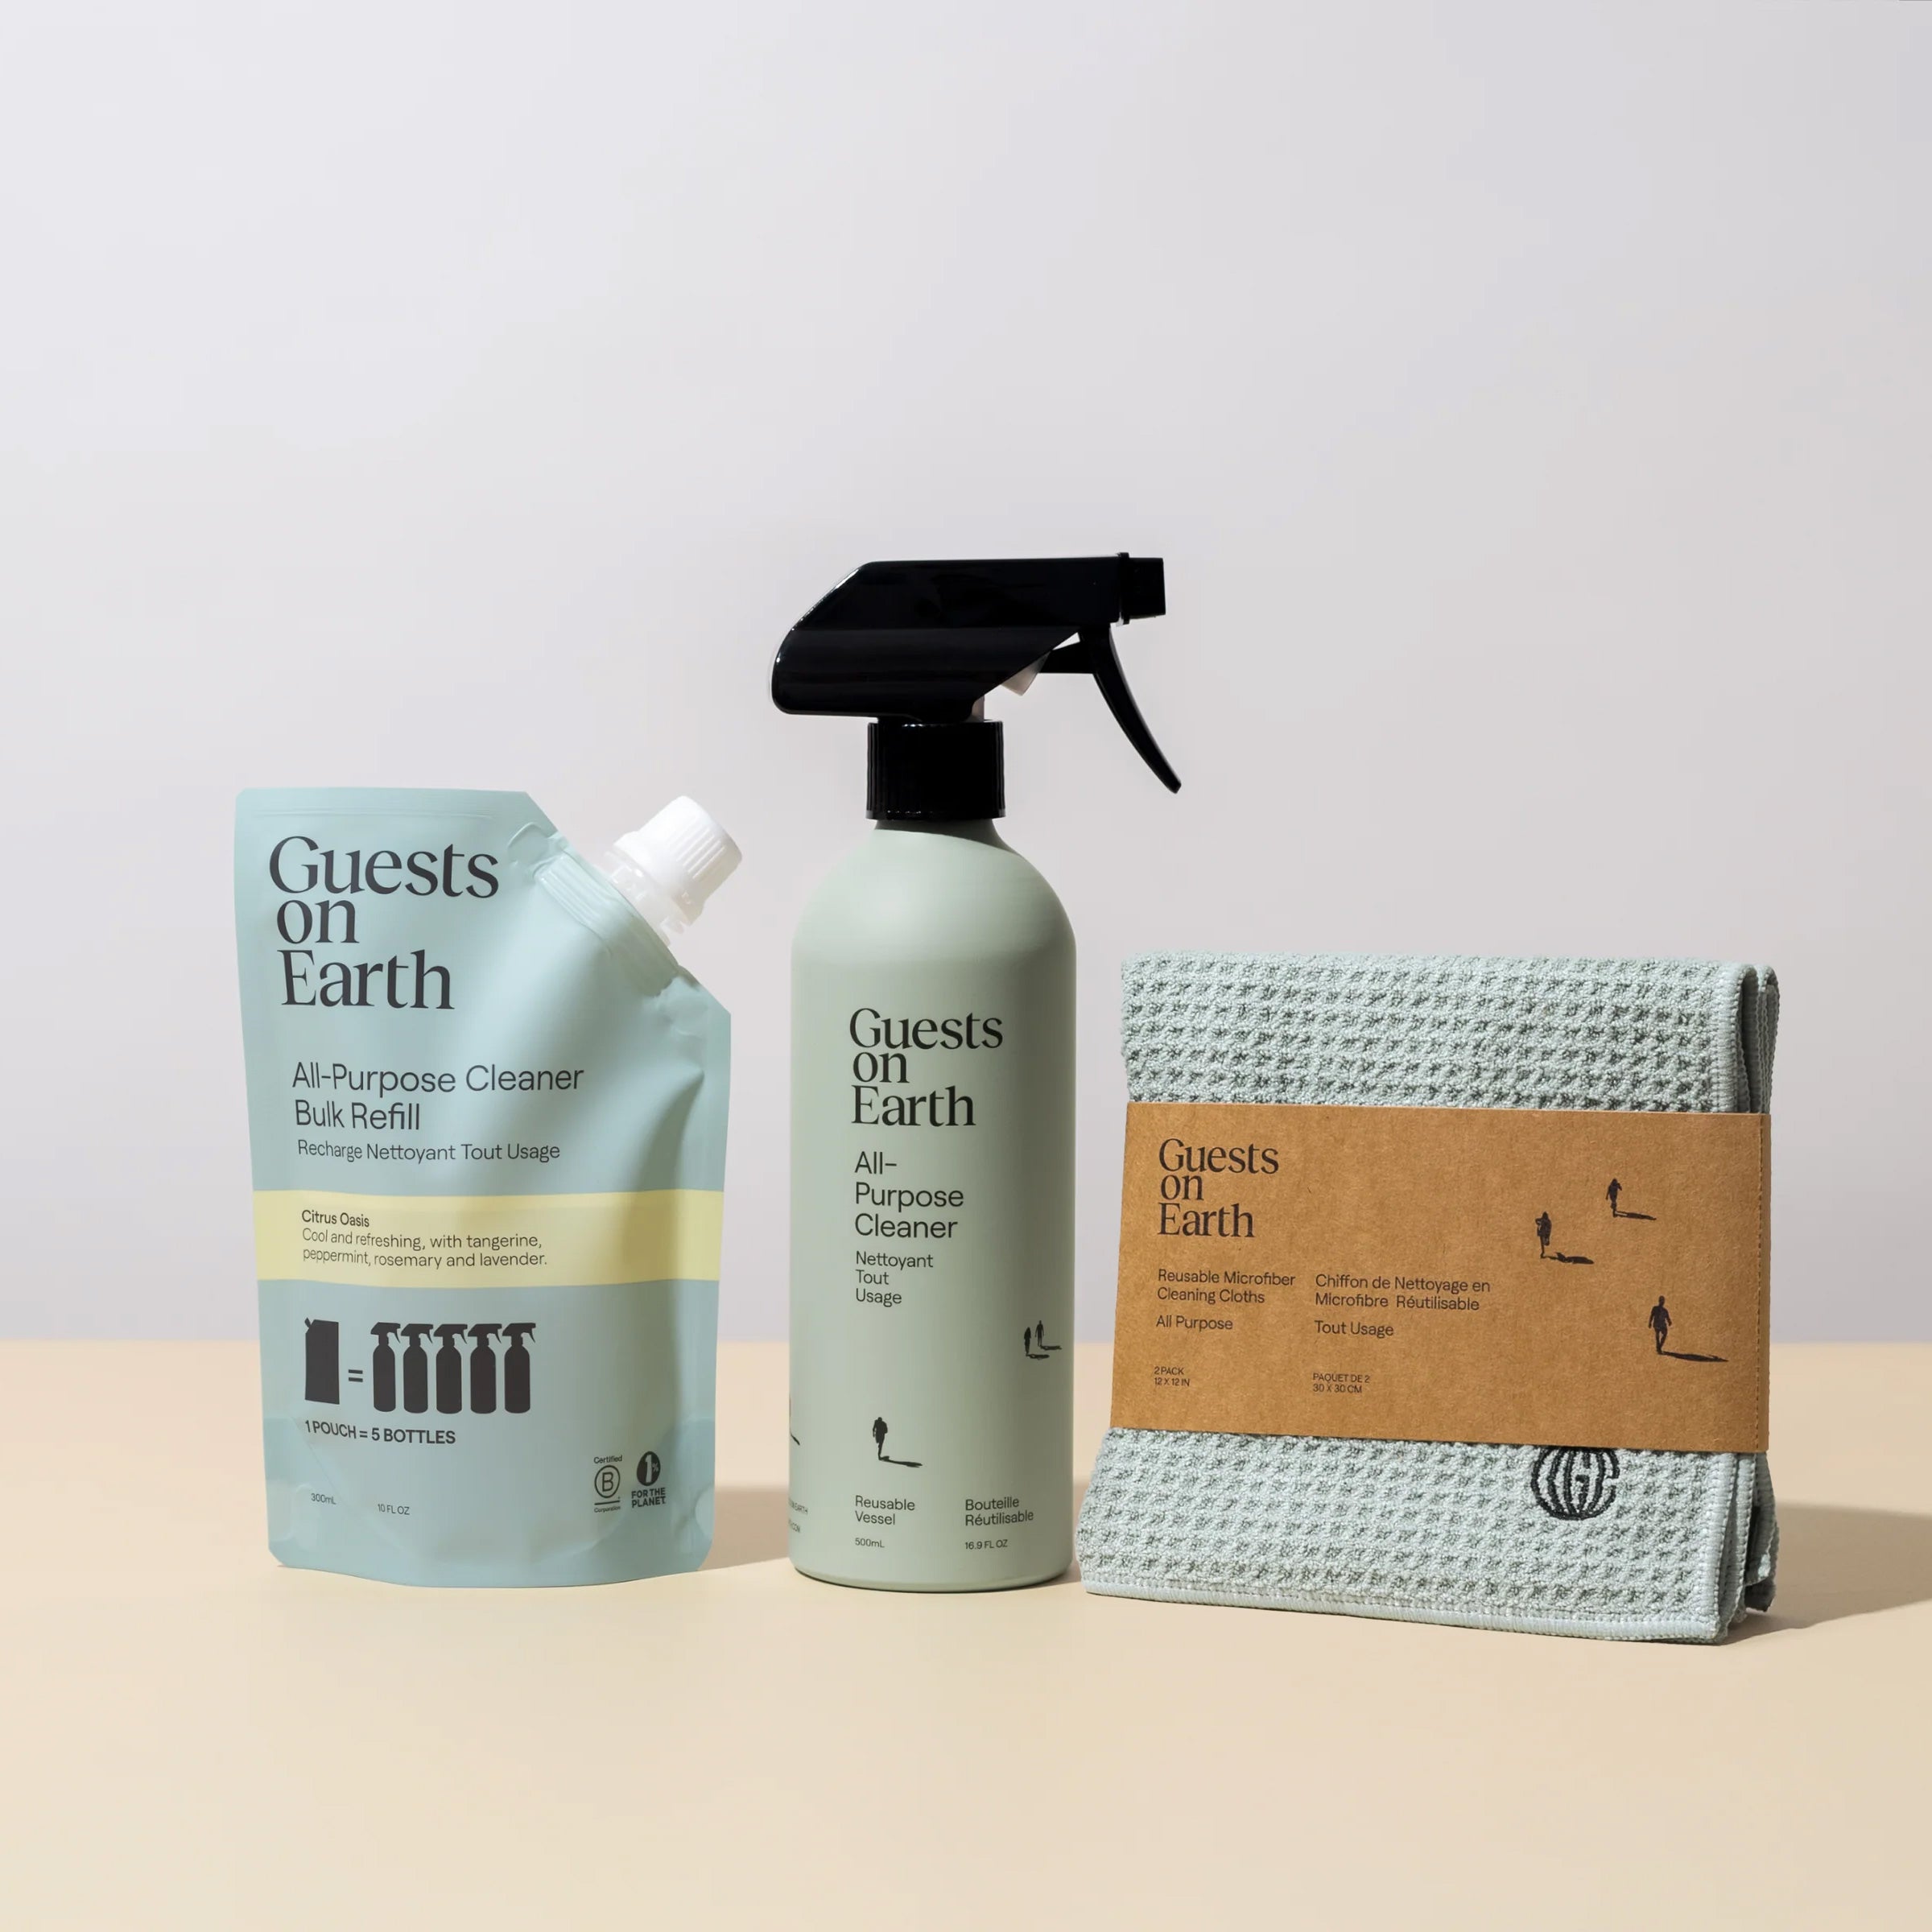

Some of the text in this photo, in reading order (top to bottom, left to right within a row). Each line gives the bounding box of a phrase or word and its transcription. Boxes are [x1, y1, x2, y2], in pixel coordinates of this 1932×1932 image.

[270, 836, 498, 898] Guests
[277, 900, 359, 944] on
[278, 949, 454, 1009] Earth
[849, 1008, 1004, 1050] Guests
[853, 1052, 910, 1083] on
[292, 1062, 584, 1098] All-Purpose Cleaner
[295, 1100, 419, 1129] Bulk Refill
[852, 1085, 976, 1127] Earth
[299, 1140, 559, 1164] Recharge Nettoyant Tout Usage
[1159, 1138, 1278, 1174] Guests
[857, 1182, 964, 1212] Purpose
[1161, 1175, 1203, 1200] on
[302, 1210, 369, 1227] Citrus Oasis
[856, 1213, 958, 1238] Cleaner
[1158, 1203, 1255, 1237] Earth
[303, 1228, 541, 1251] Cool and refreshing, with tangerine,
[303, 1249, 547, 1269] peppermint, rosemary and lavender.
[857, 1251, 933, 1270] Nettoyant
[856, 1269, 889, 1285] Tout
[1158, 1269, 1295, 1286] Reusable Microfiber
[1316, 1274, 1490, 1294] Chiffon de Nettoyage en
[857, 1288, 902, 1307] Usage
[1158, 1287, 1265, 1305] Cleaning Cloths
[1316, 1293, 1479, 1311] Microfibre Réutilisable
[1156, 1315, 1232, 1332] All Purpose
[1315, 1320, 1393, 1339] Tout Usage
[1154, 1377, 1162, 1385] 12
[1172, 1378, 1179, 1386] 12
[1313, 1373, 1370, 1383] PAQUET DE 2
[1313, 1384, 1324, 1392] 30
[1335, 1385, 1346, 1393] 30
[1348, 1385, 1362, 1393] CM
[305, 1420, 310, 1432] 1
[312, 1421, 356, 1439] POUCH
[372, 1428, 380, 1441] 5
[384, 1429, 456, 1443] BOTTLES
[594, 1455, 622, 1463] Certified
[312, 1493, 336, 1505] 300mL
[631, 1488, 665, 1499] FOR THE
[631, 1496, 666, 1508] PLANET
[856, 1495, 914, 1510] Reusable
[966, 1496, 1019, 1510] Bouteille
[378, 1504, 409, 1515] 10 FL OZ
[856, 1511, 895, 1525] Vessel
[966, 1509, 1034, 1525] Réutilisable
[856, 1538, 885, 1547] 500mL
[965, 1542, 982, 1550] 16.9
[996, 1539, 1008, 1548] OZ
